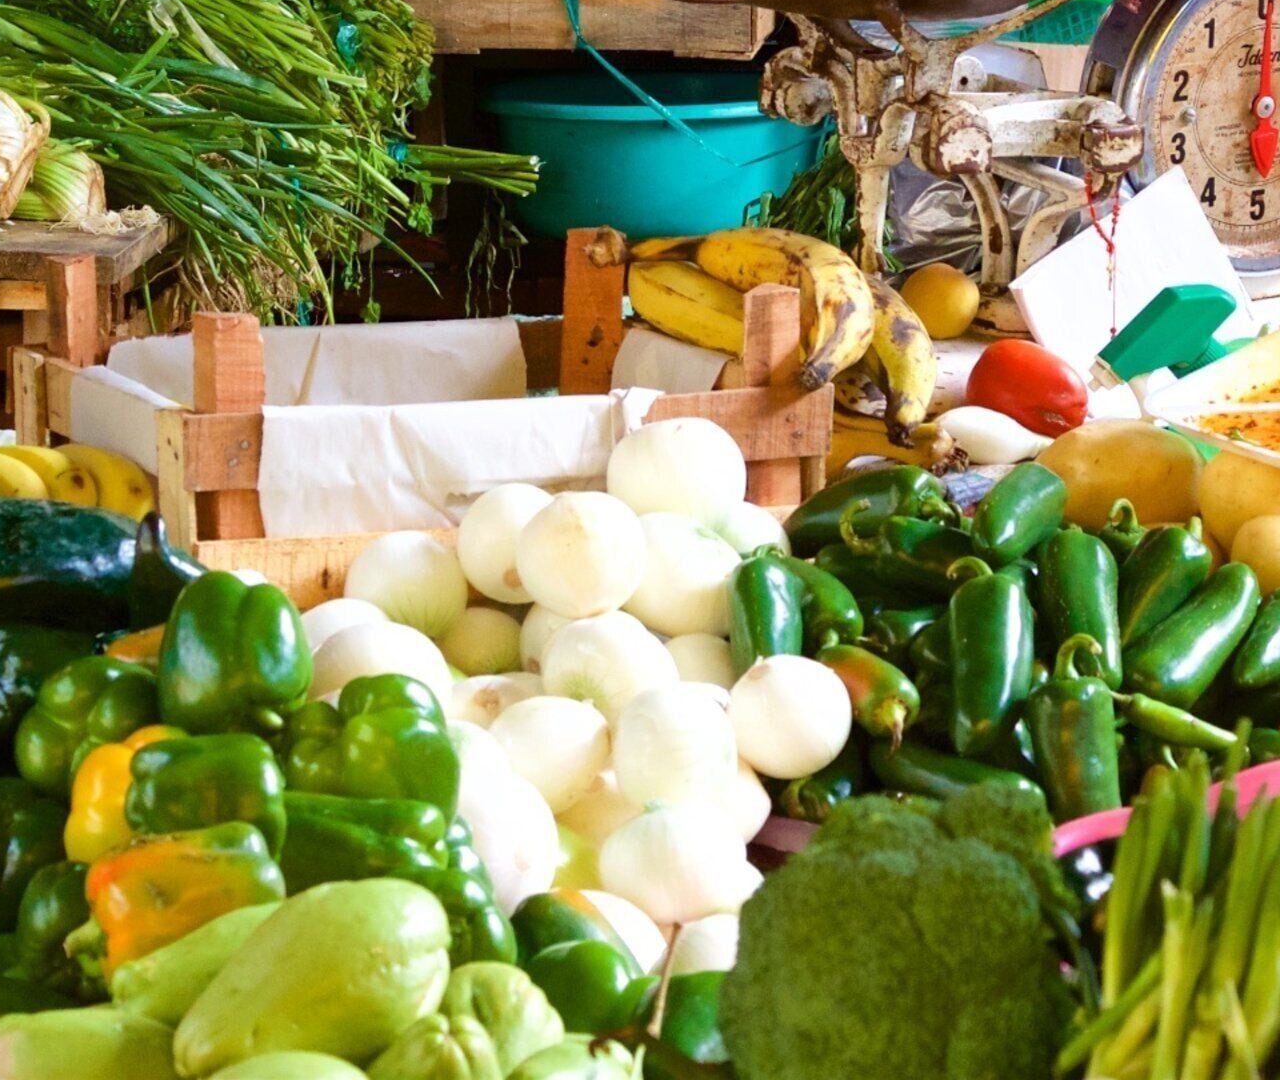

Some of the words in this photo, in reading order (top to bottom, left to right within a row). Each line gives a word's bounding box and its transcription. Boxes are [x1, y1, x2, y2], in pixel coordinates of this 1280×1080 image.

[1203, 18, 1216, 49] 1
[1173, 70, 1189, 102] 2
[1170, 132, 1186, 165] 3
[1200, 177, 1216, 207] 4
[1249, 189, 1265, 221] 5
